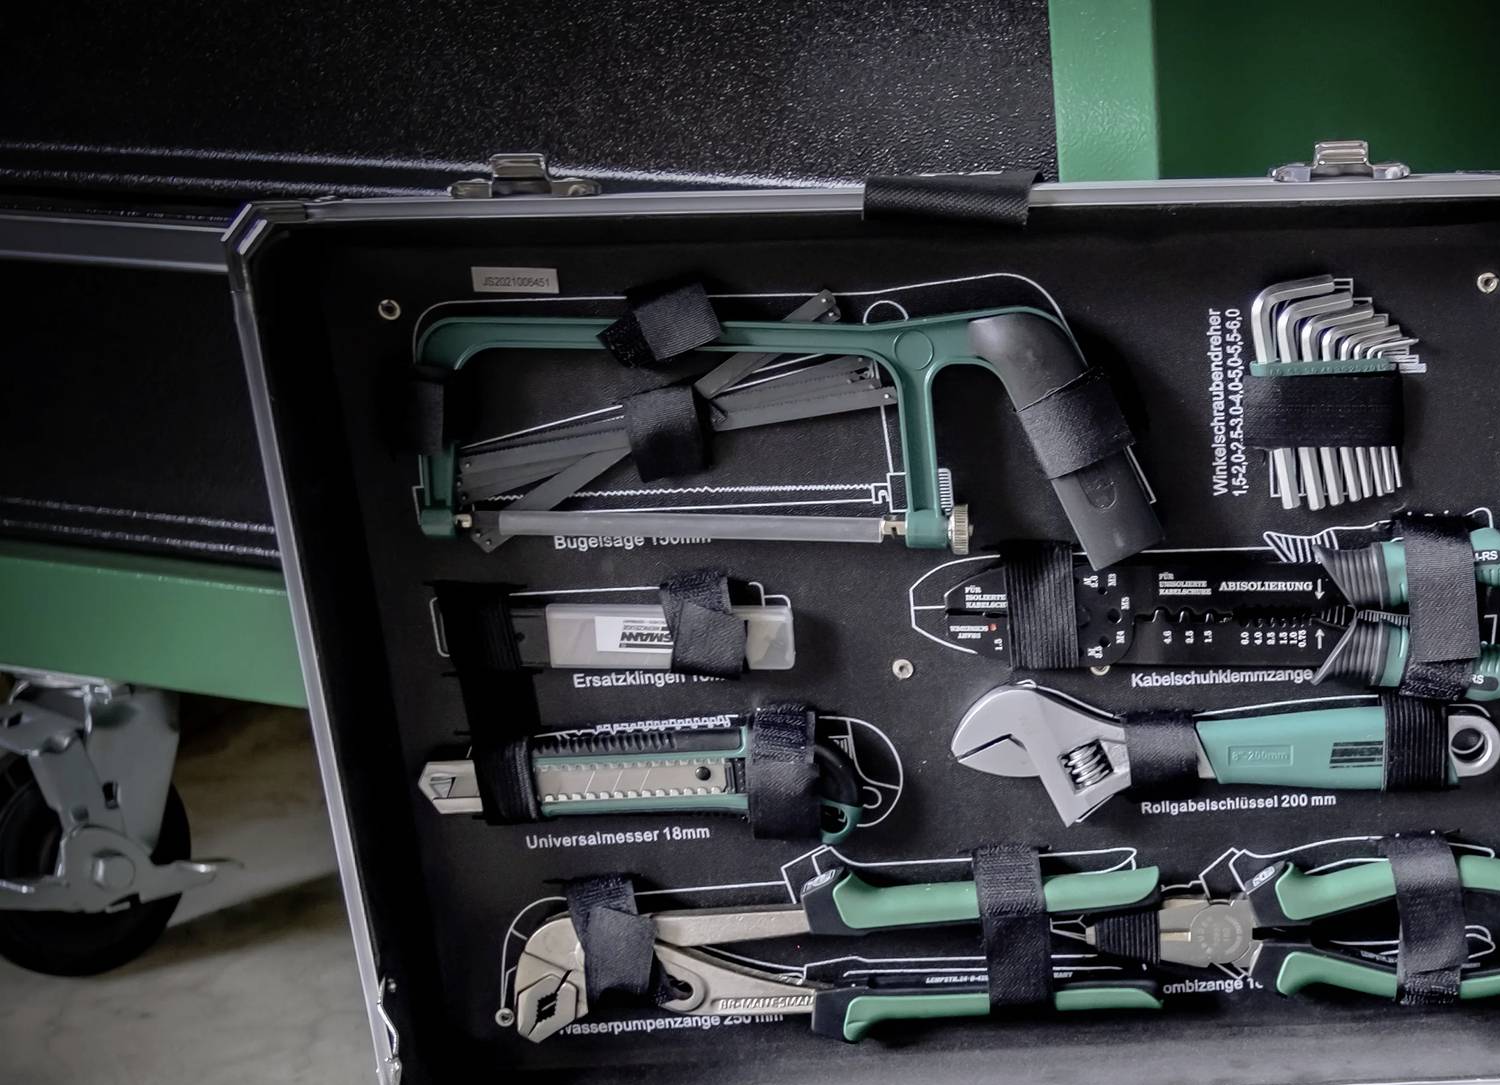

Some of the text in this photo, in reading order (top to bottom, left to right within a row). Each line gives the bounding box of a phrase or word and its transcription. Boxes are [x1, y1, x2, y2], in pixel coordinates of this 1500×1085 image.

[1207, 308, 1228, 496] Winkelschraubendreher
[1219, 581, 1313, 592] ABISOLIERUNG
[620, 632, 673, 642] SMANN
[573, 670, 685, 688] Ersatzklingen
[1131, 669, 1313, 688] Kabelschuhklemmzange
[1141, 793, 1337, 815] Rollgabelschlüssel 200 mm
[526, 826, 710, 849] Universalmesser 18mm
[1163, 979, 1243, 994] ombizange
